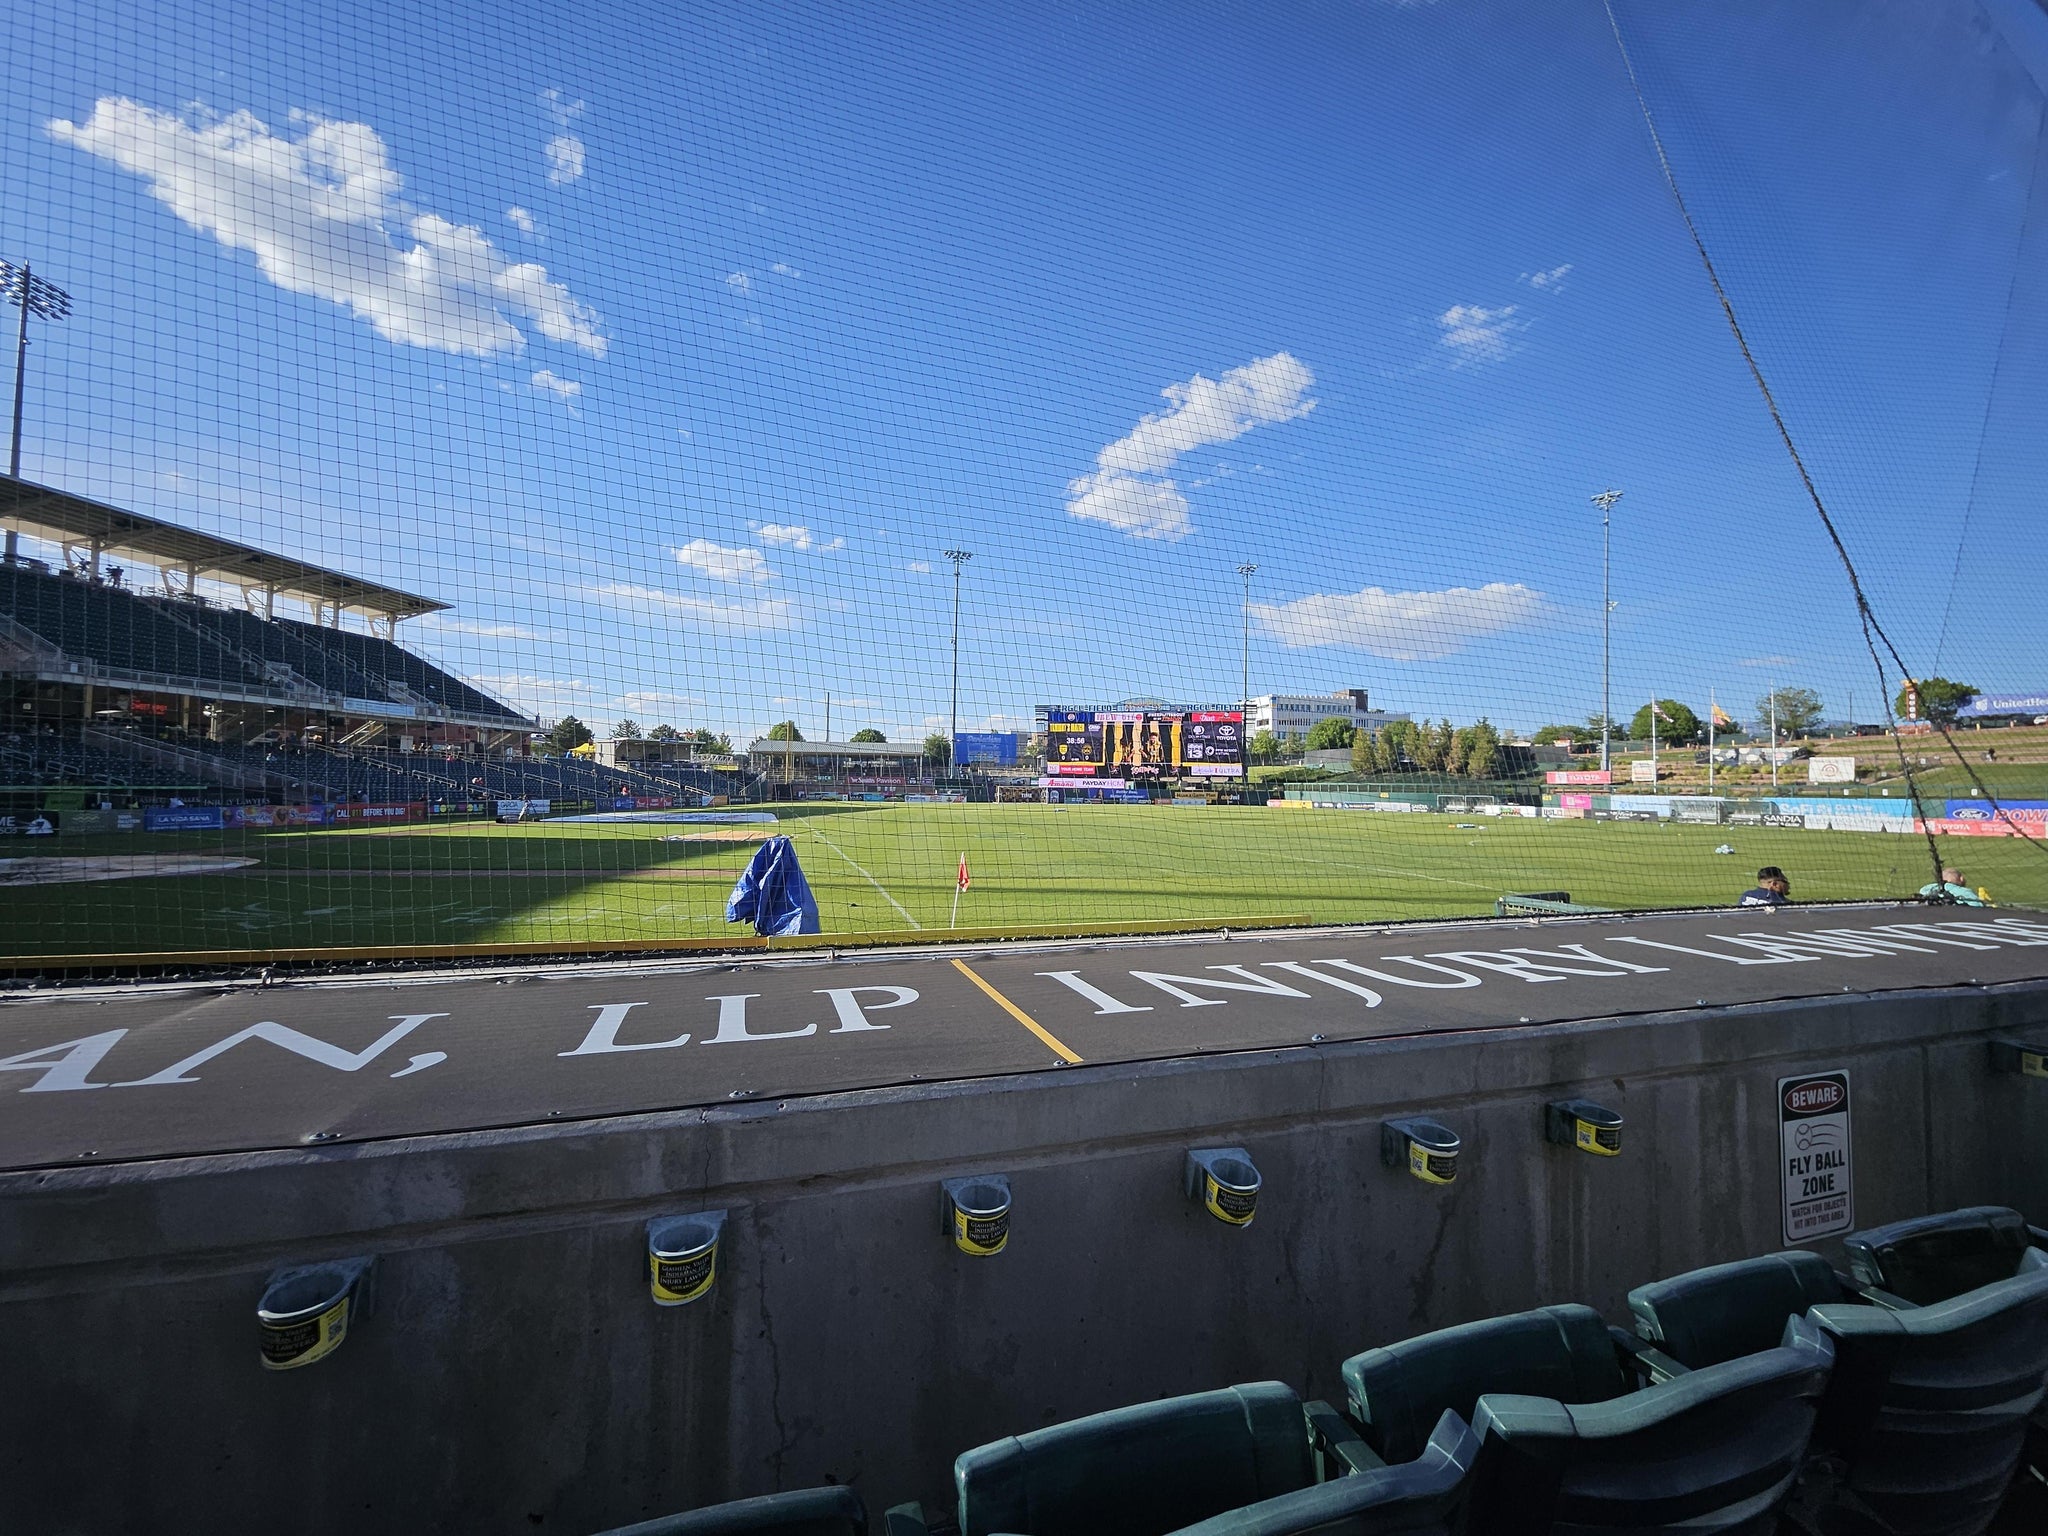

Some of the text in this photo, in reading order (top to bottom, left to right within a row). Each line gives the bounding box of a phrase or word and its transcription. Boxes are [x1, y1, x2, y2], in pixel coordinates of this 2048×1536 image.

[336, 808, 351, 818] CALL
[363, 807, 383, 817] BEFORE
[384, 807, 394, 816] YOU
[1763, 814, 1802, 824] SANDIA
[1959, 809, 1984, 820] Ford
[1937, 823, 1970, 831] TOYOTA
[1034, 944, 1671, 1015] INJURY
[557, 985, 920, 1058] LLP
[1791, 1086, 1838, 1108] BEWARE
[1789, 1149, 1845, 1177] FLY BALL
[1802, 1173, 1835, 1197] ZONE
[1811, 1202, 1822, 1214] FOR
[1823, 1197, 1847, 1211] OBJECTS
[1794, 1209, 1845, 1230] HIT INTO THIS AREA
[660, 1275, 683, 1286] INJURY
[684, 1267, 711, 1284] LAWYERS
